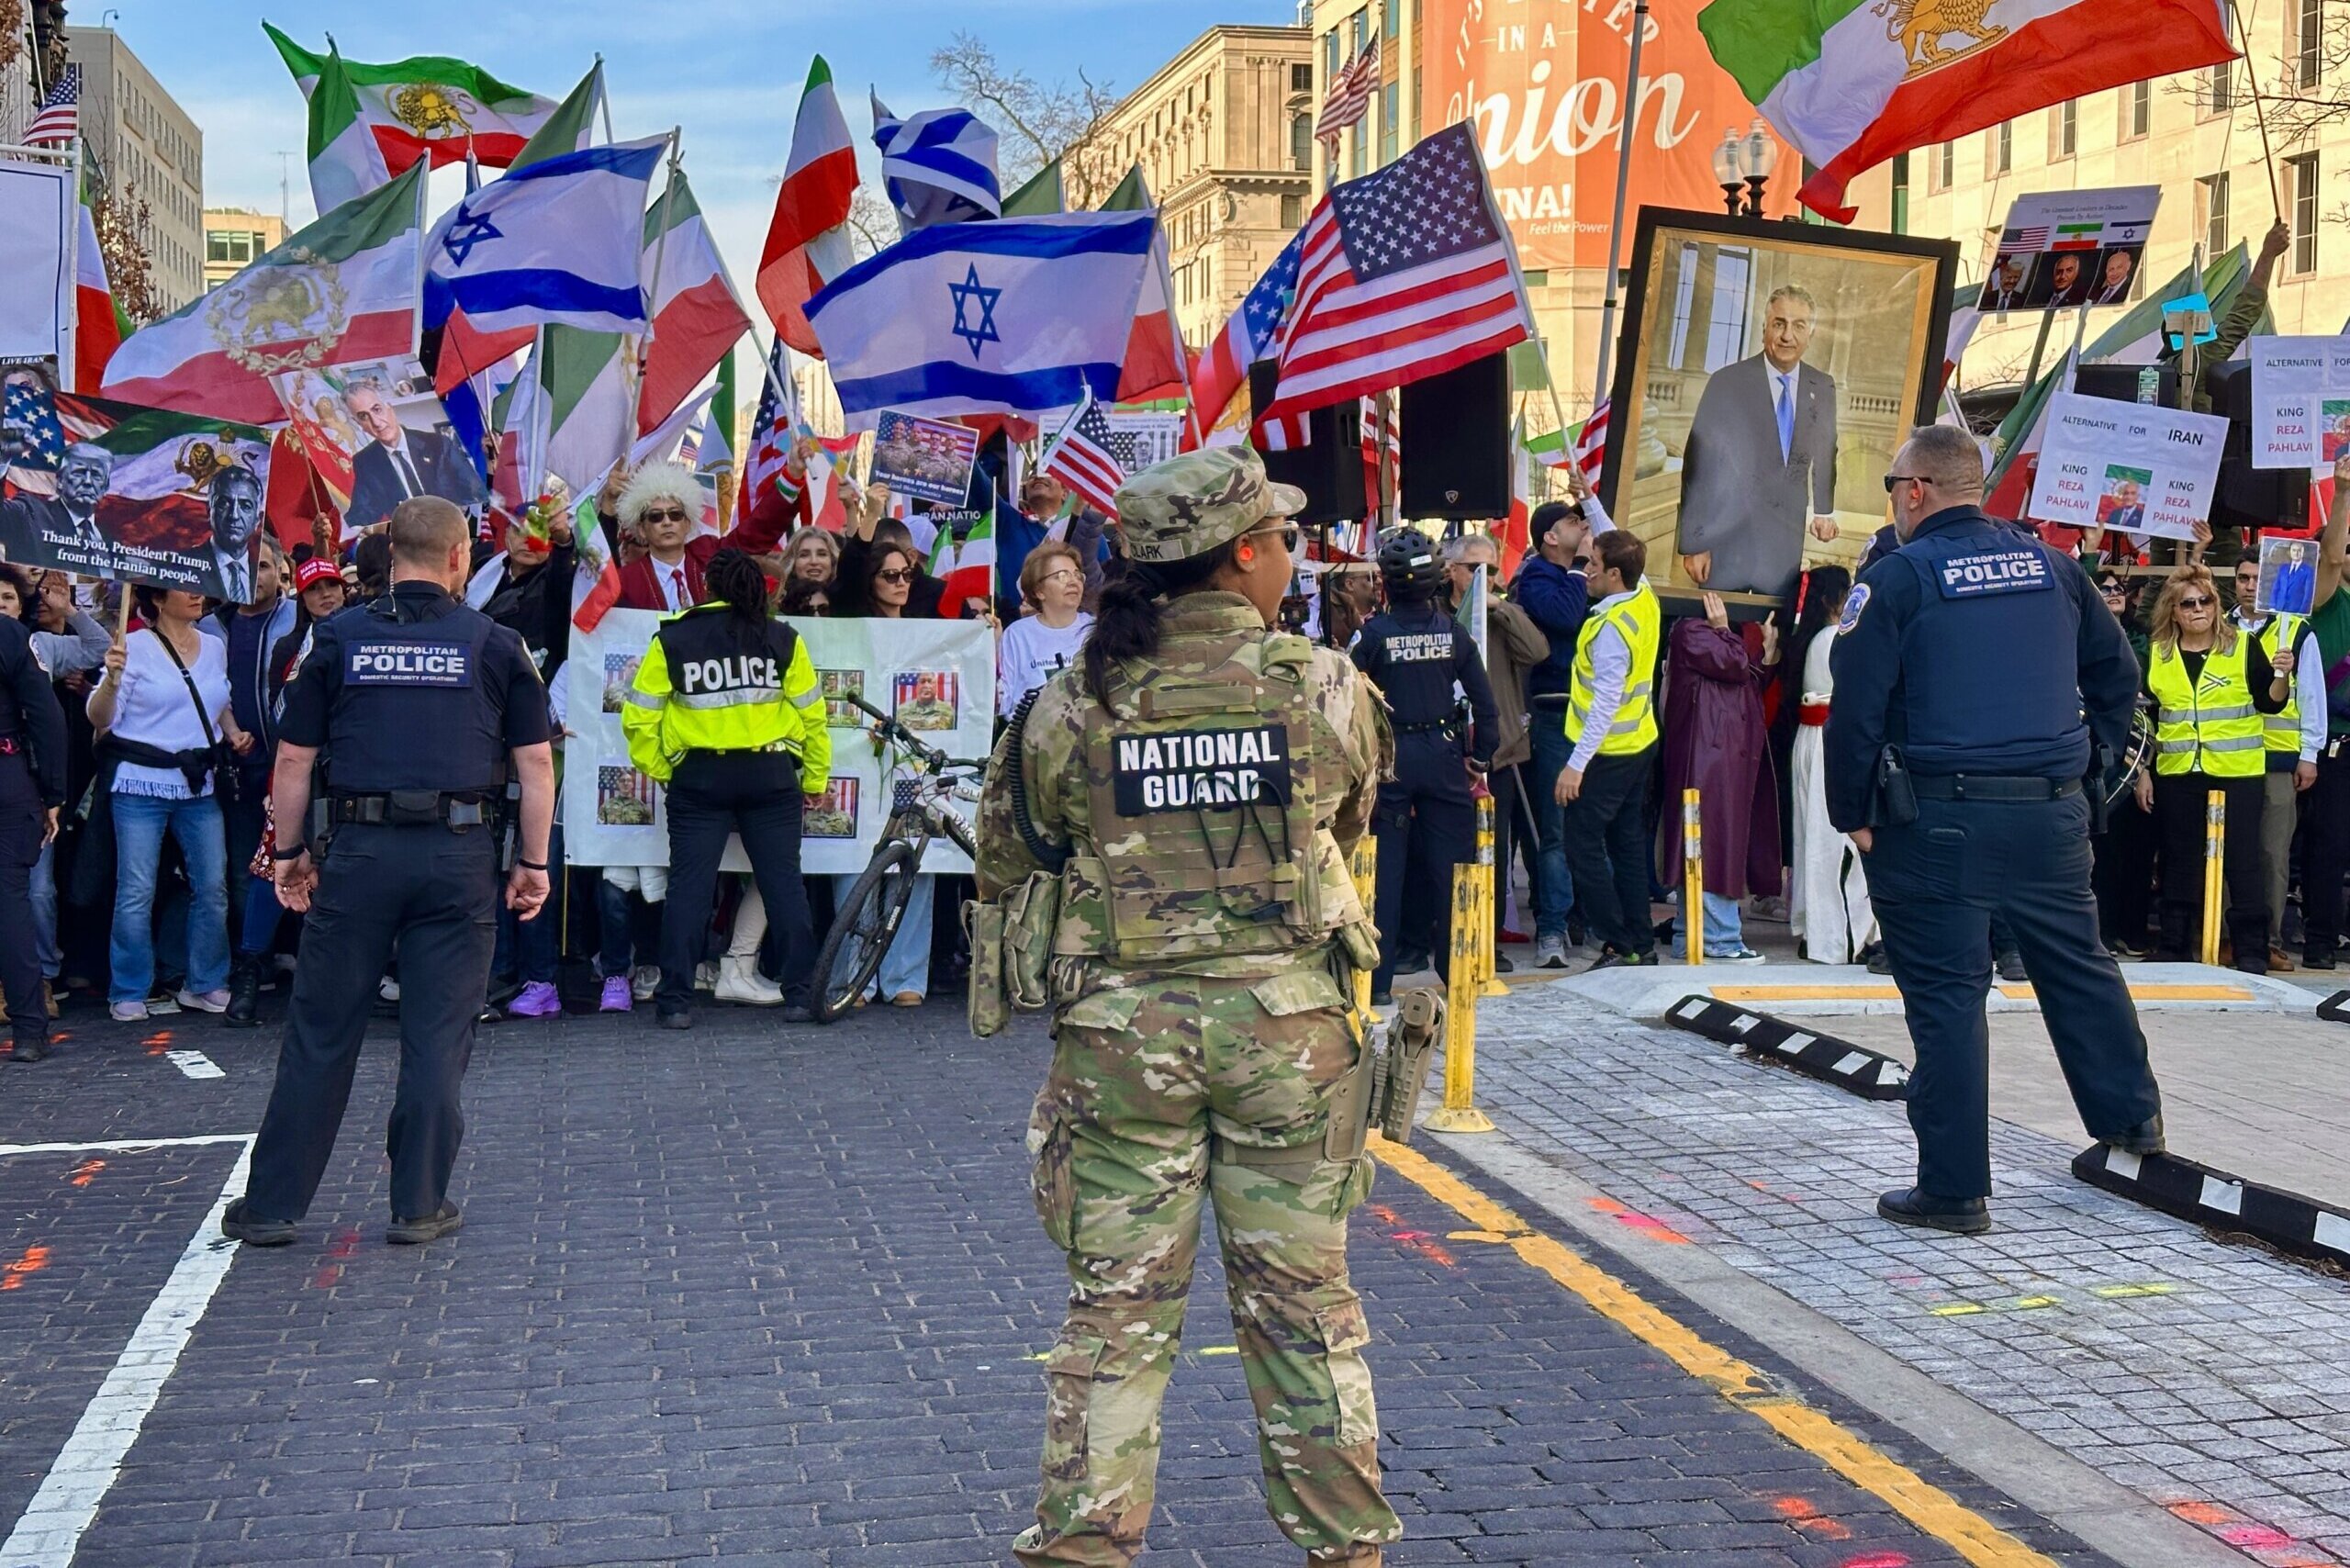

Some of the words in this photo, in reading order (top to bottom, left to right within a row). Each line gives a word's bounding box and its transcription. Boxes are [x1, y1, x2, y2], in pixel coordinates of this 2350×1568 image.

[1498, 25, 1526, 52] IN
[1540, 22, 1557, 49] A
[1528, 222, 1551, 235] Feel
[1552, 221, 1571, 233] the
[1572, 220, 1609, 234] Power
[2, 356, 21, 365] LIVE
[23, 355, 45, 364] IRAN
[2266, 358, 2324, 367] ALTERNATIVE
[2277, 407, 2304, 418] KING
[2062, 415, 2118, 431] ALTERNATIVE
[2129, 425, 2146, 436] FOR
[2167, 428, 2203, 446] IRAN
[2276, 424, 2304, 435] REZA
[2267, 442, 2313, 453] PAHLAVI
[2061, 464, 2087, 476] KING
[2058, 479, 2084, 492] REZA
[2168, 479, 2195, 492] KING
[2046, 495, 2089, 510] PAHLAVI
[2165, 496, 2190, 509] REZA
[42, 530, 81, 547] Thank
[84, 539, 109, 553] you,
[112, 542, 168, 563] President
[171, 552, 212, 572] Trump,
[57, 548, 87, 564] from
[90, 554, 111, 568] the
[113, 557, 157, 576] Iranian
[159, 568, 201, 585] people.
[1947, 552, 2033, 567] METROPOLITAN
[1943, 560, 2045, 585] POLICE
[1386, 633, 1452, 649] METROPOLITAN
[360, 645, 459, 655] METROPOLITAN
[1391, 645, 1451, 661] POLICE
[352, 655, 465, 674] POLICE
[682, 655, 782, 694] POLICE
[1119, 731, 1281, 772] NATIONAL
[1142, 769, 1260, 808] GUARD
